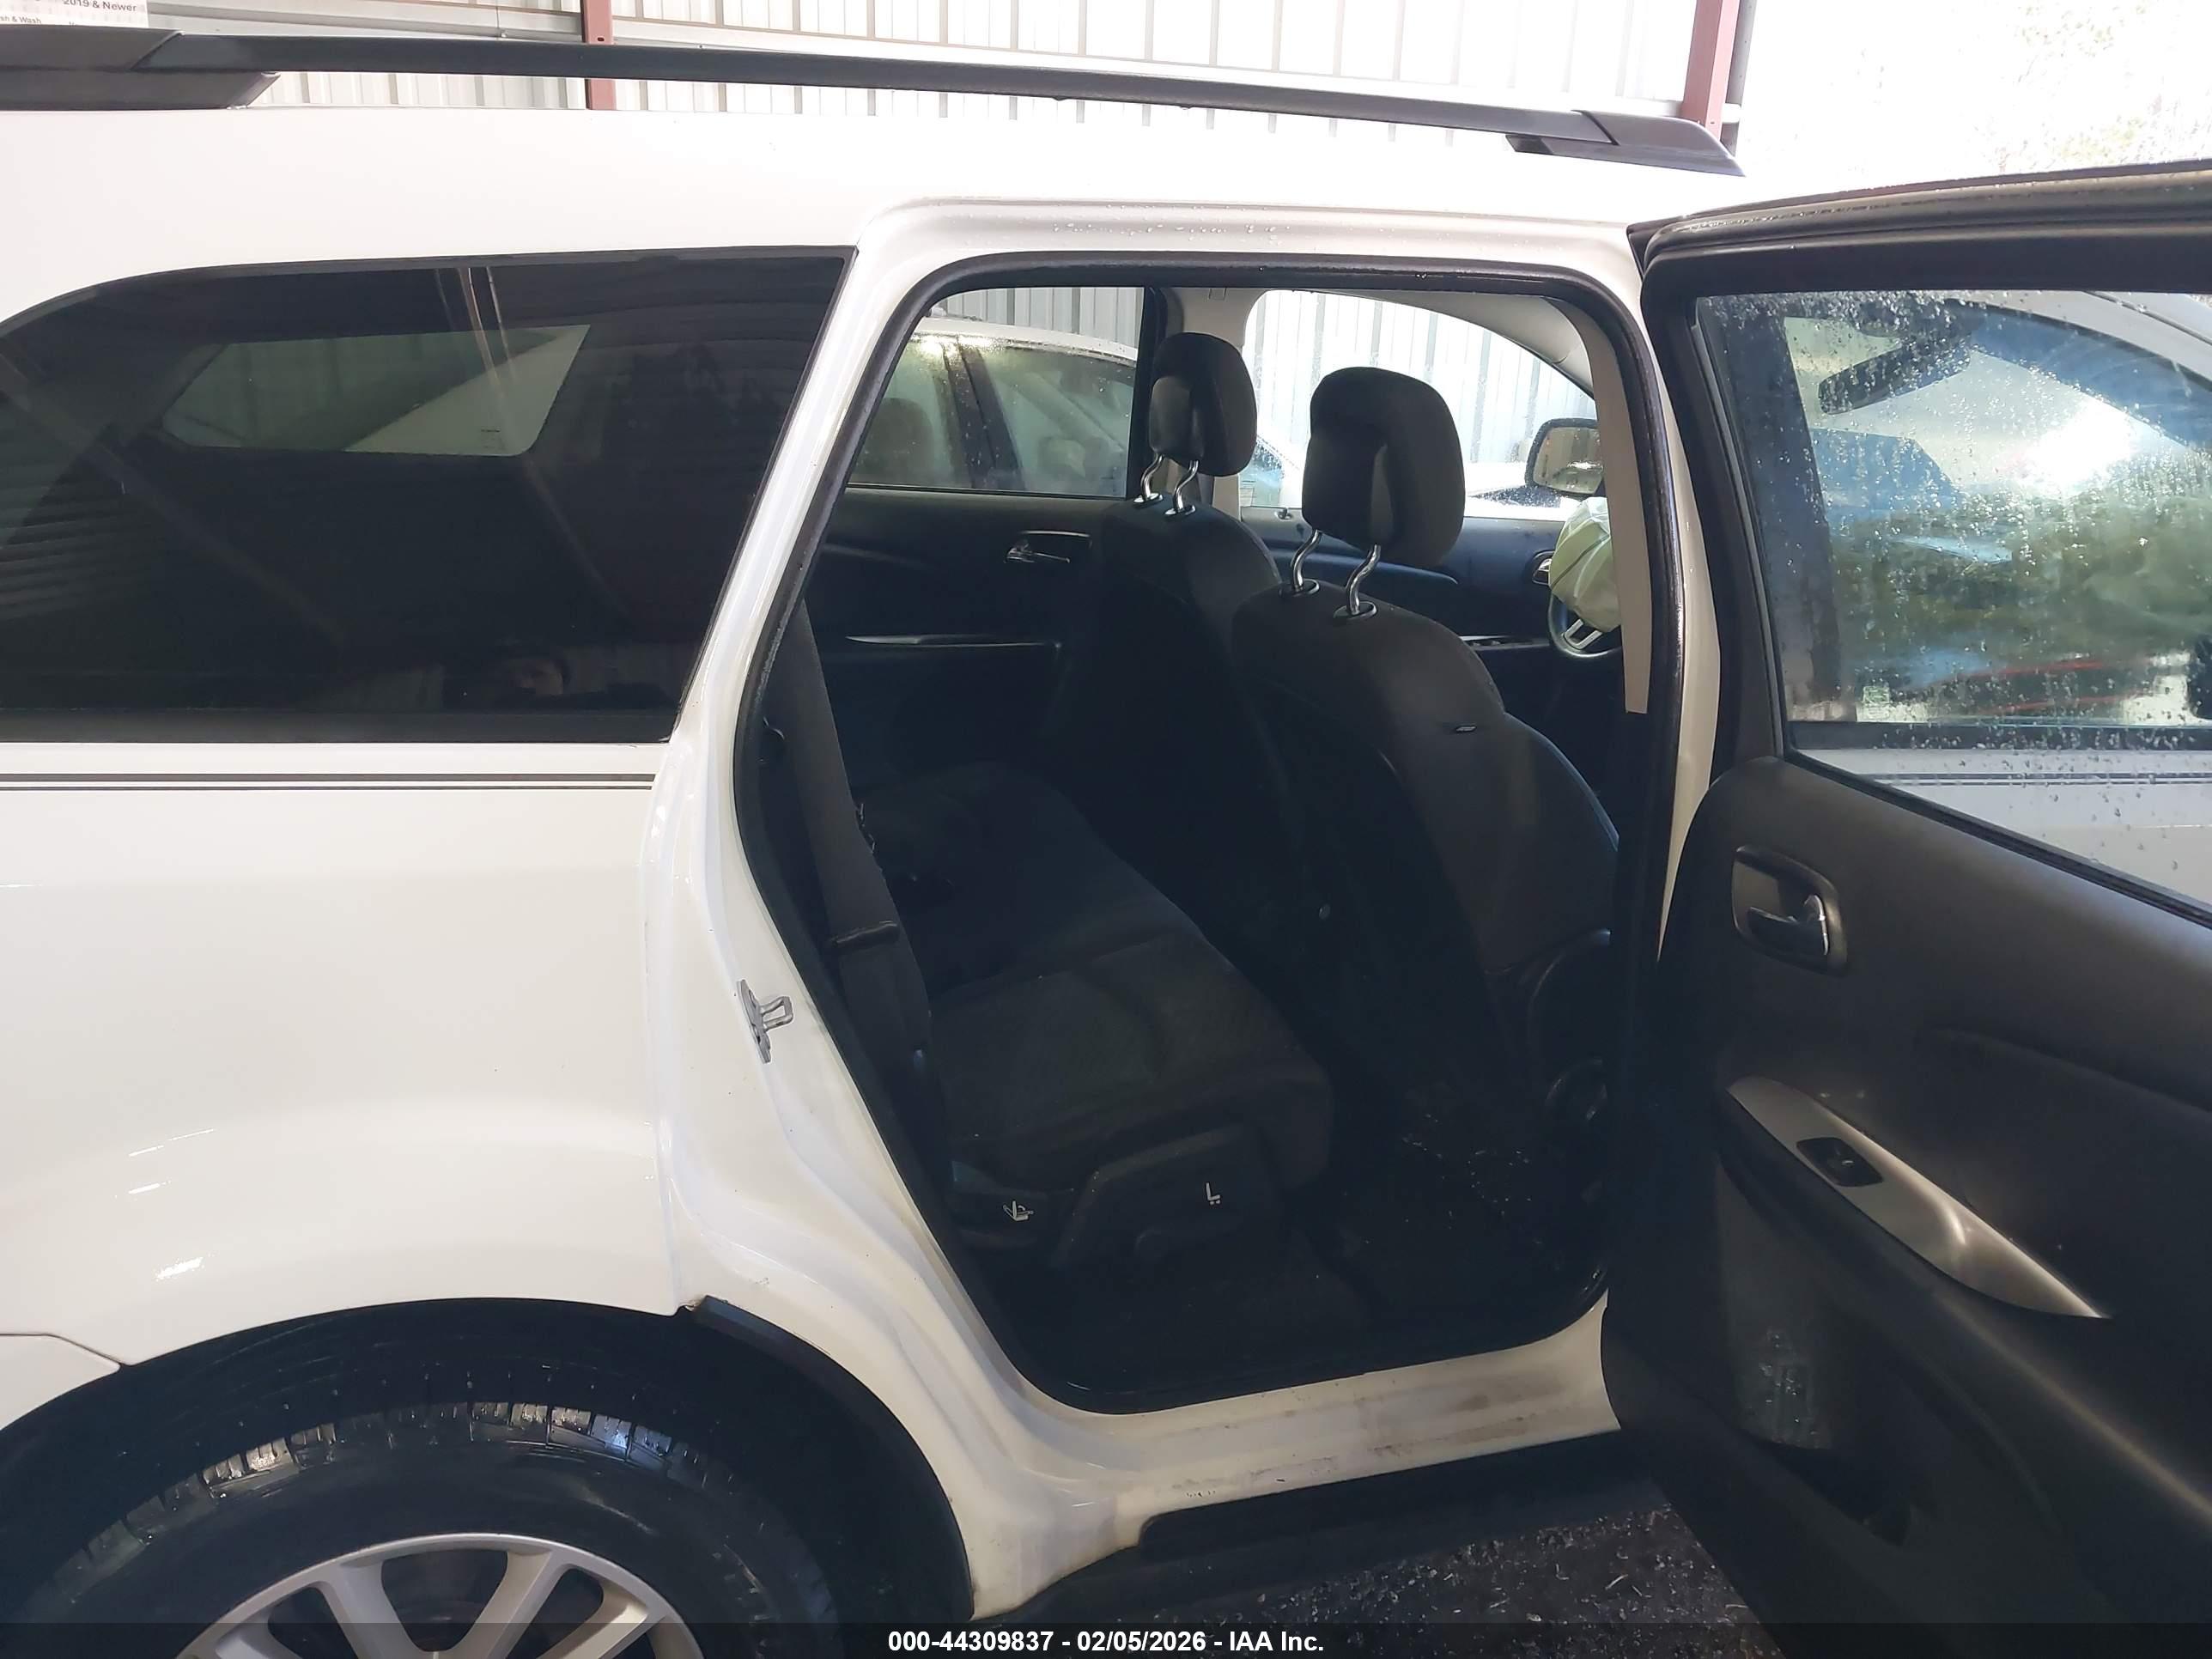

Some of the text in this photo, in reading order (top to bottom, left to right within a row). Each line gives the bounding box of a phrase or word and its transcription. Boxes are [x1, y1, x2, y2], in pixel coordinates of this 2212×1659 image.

[92, 0, 100, 9] &
[102, 1, 137, 11] Newer
[19, 15, 42, 24] Wash
